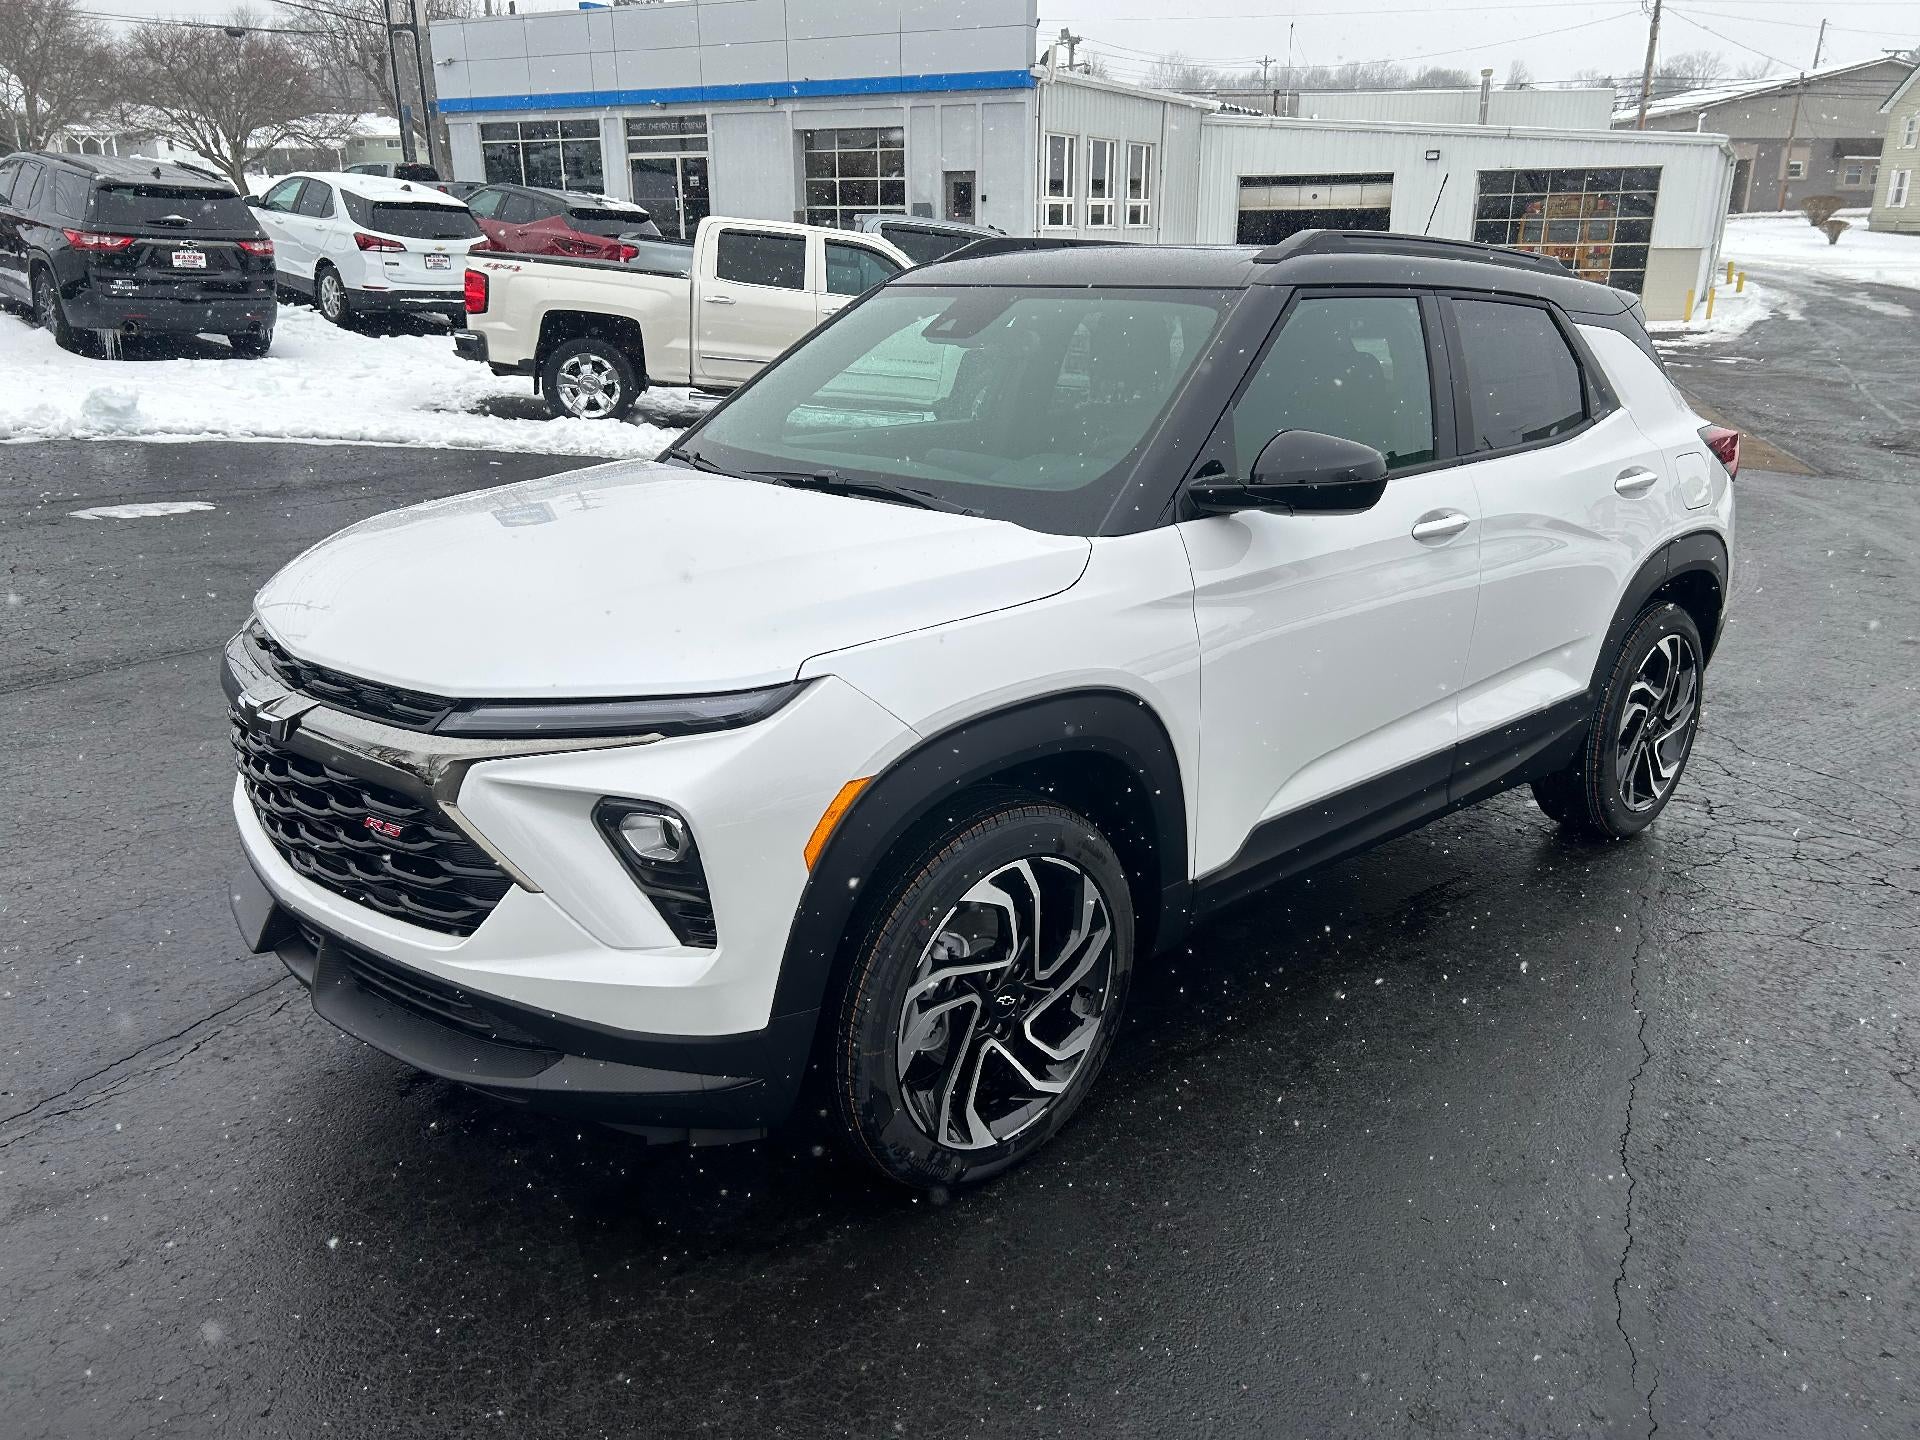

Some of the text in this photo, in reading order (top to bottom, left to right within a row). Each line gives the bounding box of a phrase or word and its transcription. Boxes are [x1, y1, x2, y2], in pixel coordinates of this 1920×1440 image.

[648, 121, 679, 130] CHEVROLET
[681, 120, 706, 129] COMPANY
[363, 816, 403, 837] RS
